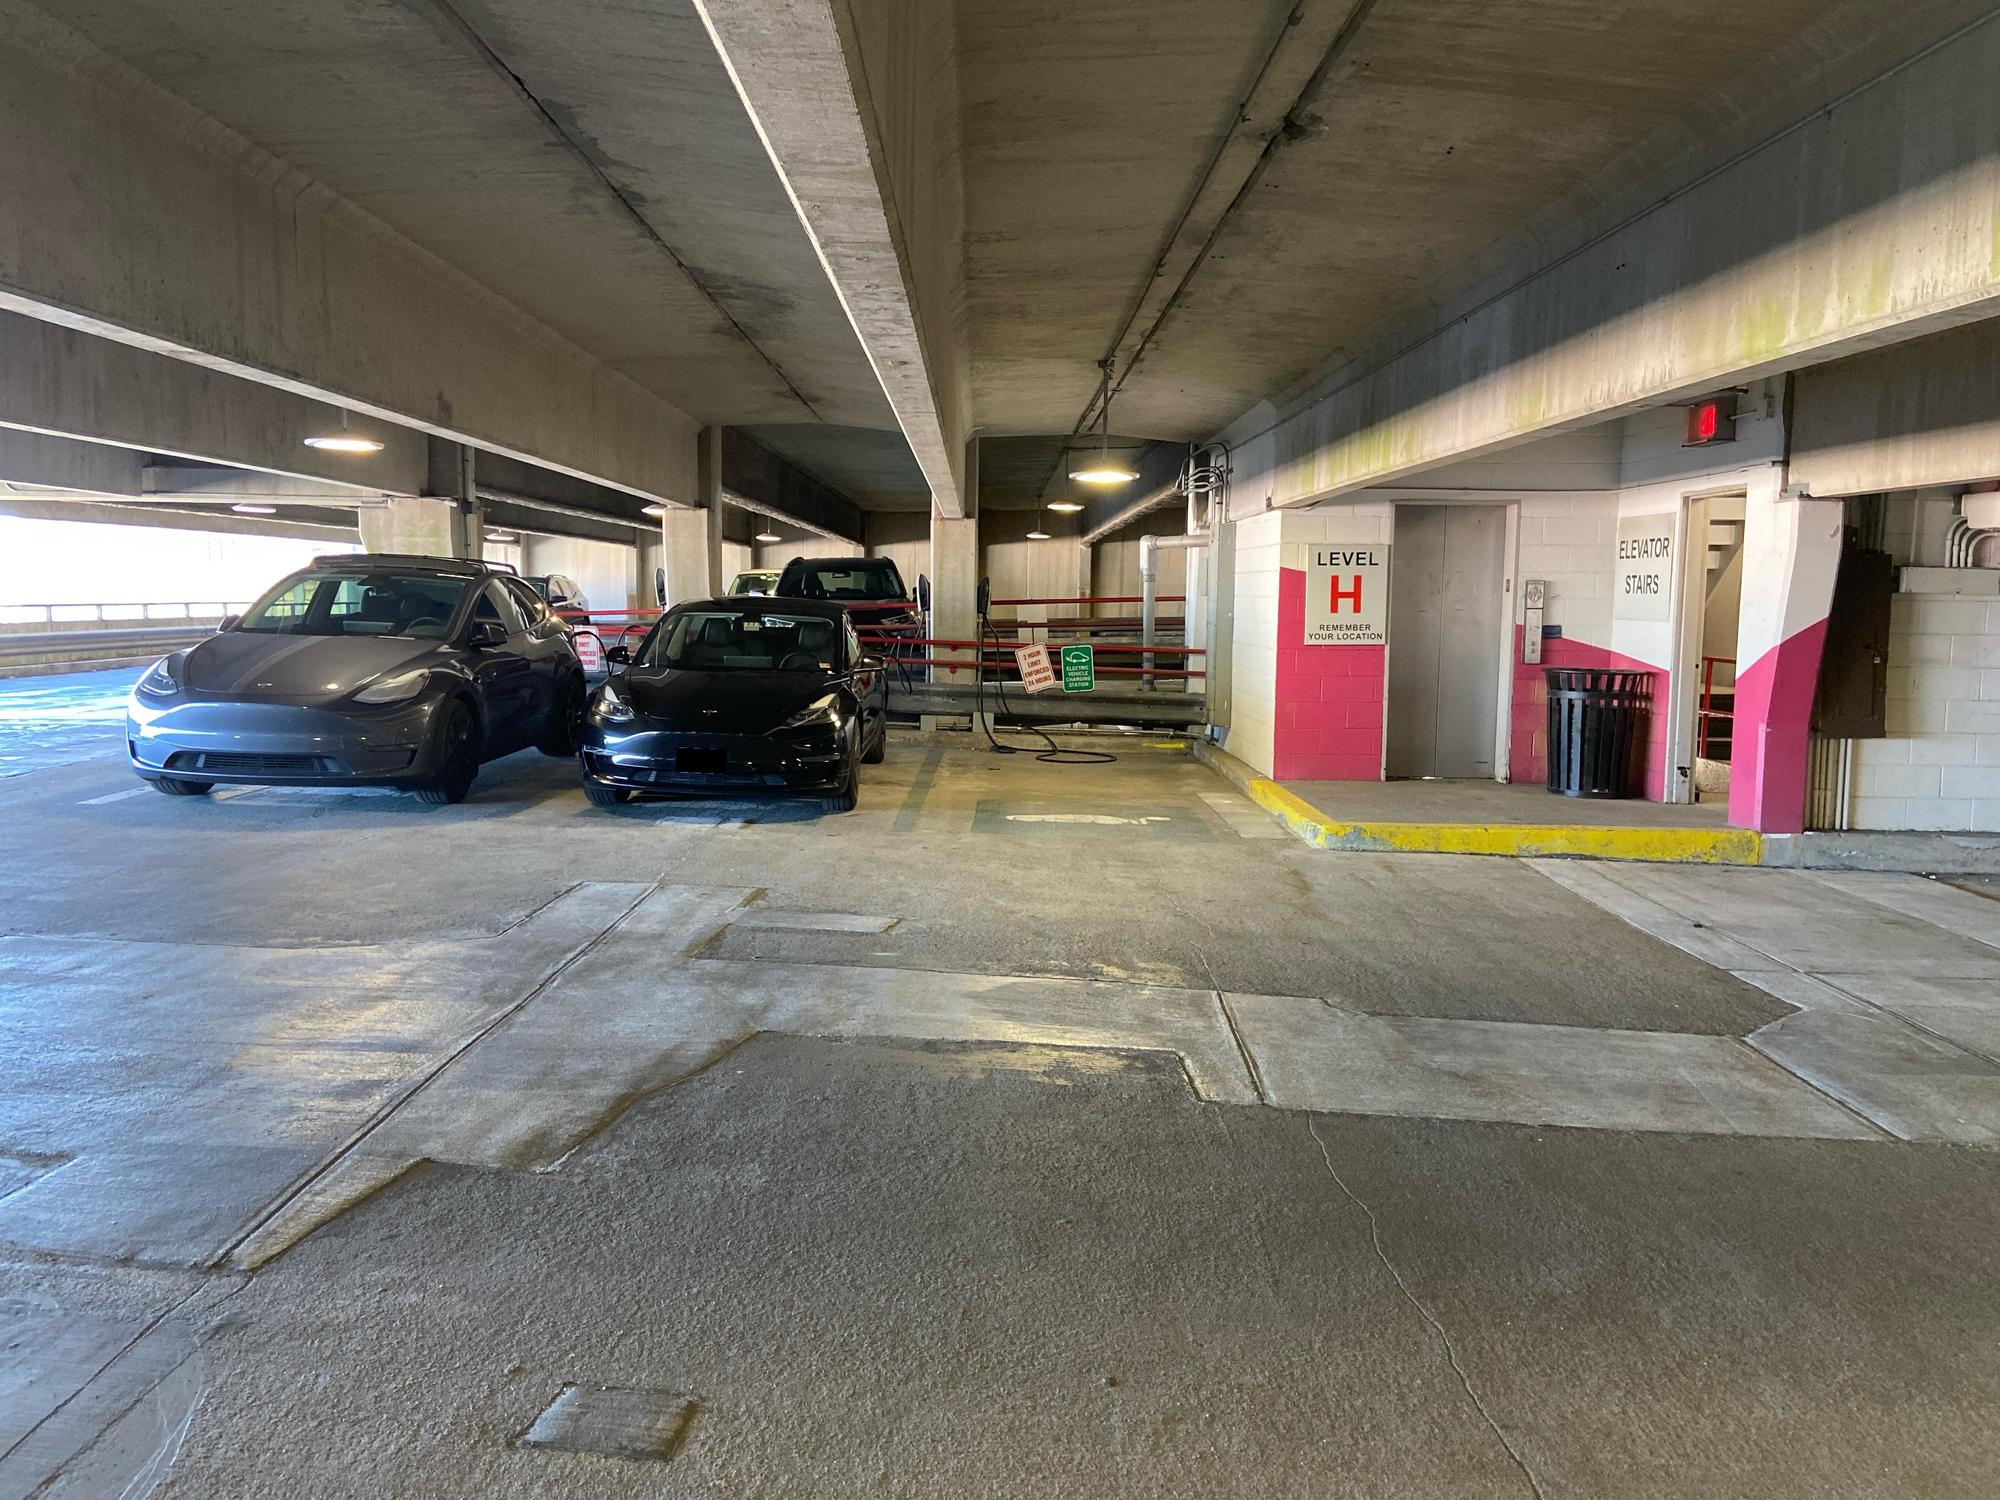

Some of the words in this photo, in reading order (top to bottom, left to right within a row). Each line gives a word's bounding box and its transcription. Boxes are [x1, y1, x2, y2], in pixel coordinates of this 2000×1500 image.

[1619, 537, 1670, 559] ELEVATOR
[1317, 551, 1380, 566] LEVEL
[1625, 574, 1660, 595] STAIRS
[1330, 574, 1362, 614] H
[1319, 624, 1371, 632] REMEMBER
[1336, 632, 1383, 640] LOCATION
[1025, 666, 1049, 678] ENFORCED
[1035, 675, 1051, 684] HOURS
